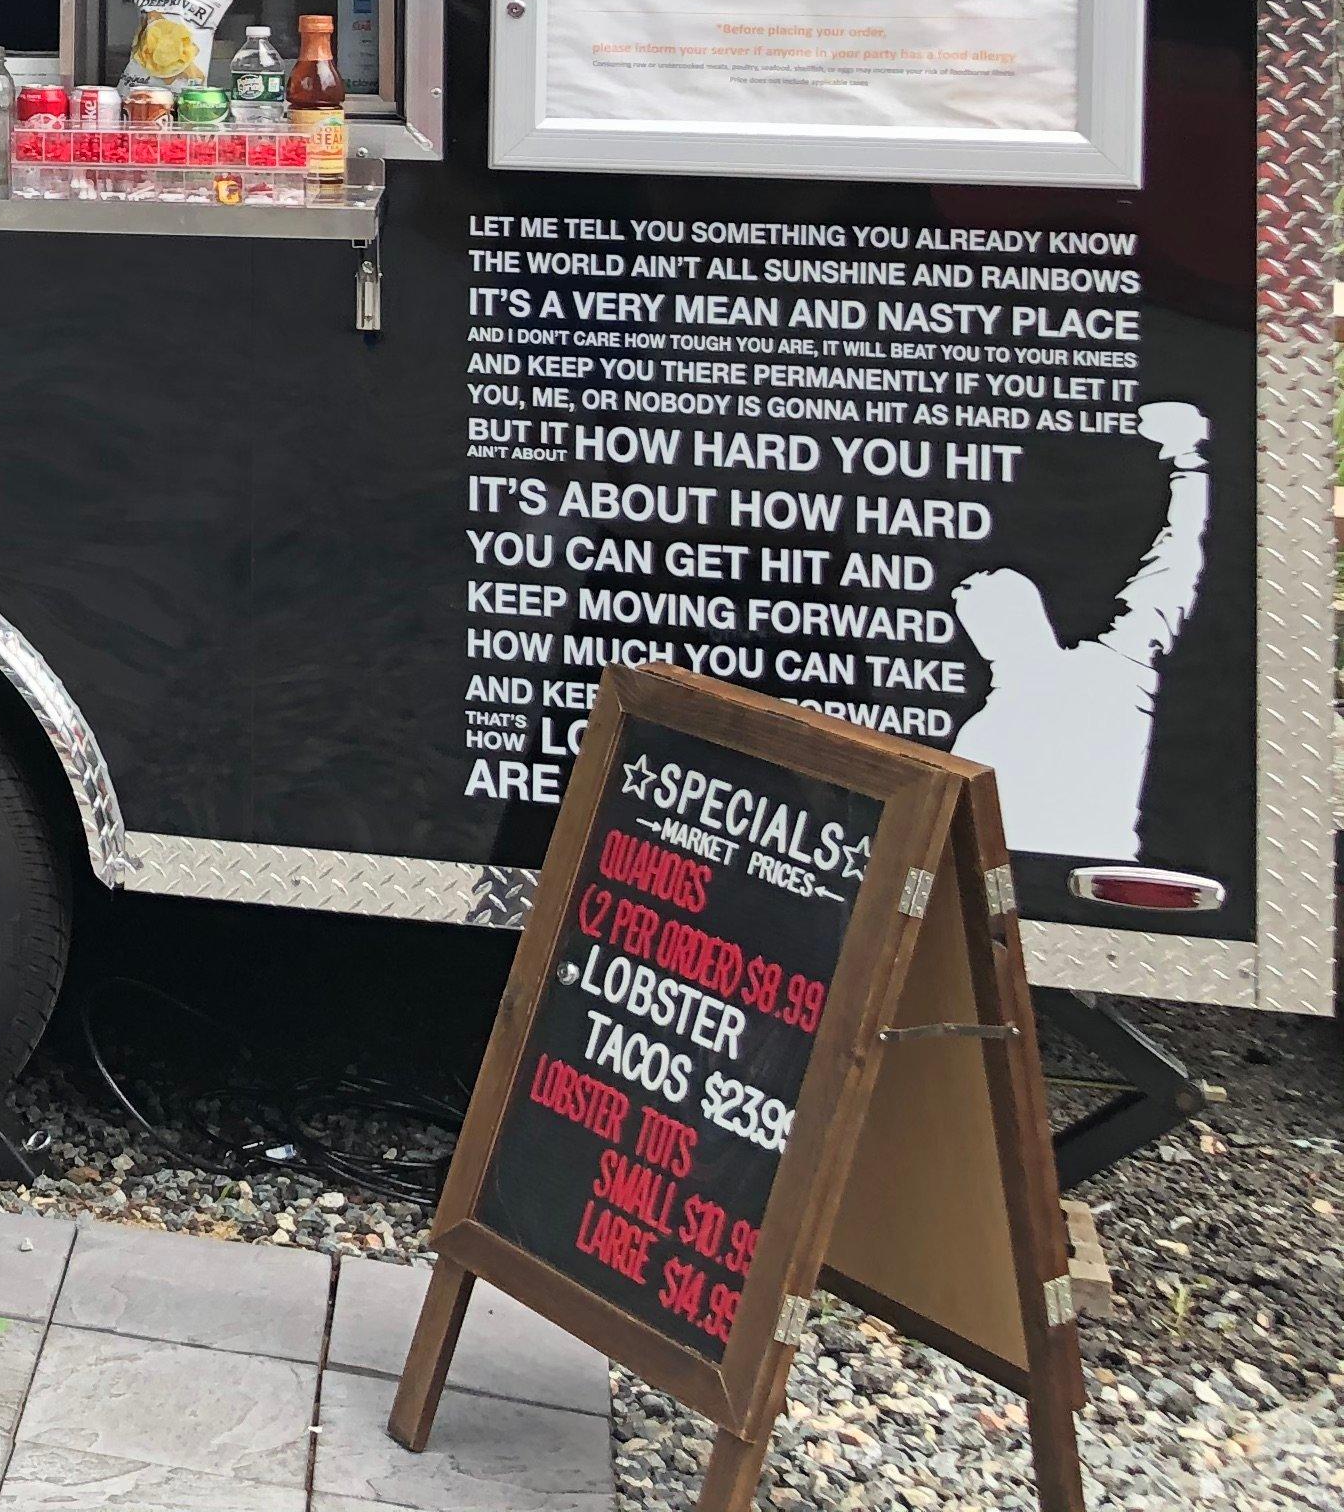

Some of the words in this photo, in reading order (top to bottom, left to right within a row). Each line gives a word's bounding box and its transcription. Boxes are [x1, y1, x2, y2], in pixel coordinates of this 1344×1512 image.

[467, 327, 503, 342] AND
[508, 329, 513, 342] I
[518, 329, 570, 345] DON'T
[574, 331, 620, 347] CARE
[625, 333, 666, 348] HOW
[670, 335, 732, 351] TOUGH
[736, 337, 773, 353] YOU
[778, 339, 818, 357] ARE,
[823, 340, 839, 355] IT
[843, 341, 887, 357] WILL
[891, 343, 937, 359] BEAT
[940, 345, 979, 361] YOU
[984, 347, 1010, 363] TO
[1014, 348, 1068, 365] YOUR
[1073, 350, 1137, 368] KNEES
[470, 288, 530, 317] IT'S
[539, 291, 565, 318] A
[573, 291, 665, 322] VERY
[676, 295, 778, 326] MEAN
[788, 299, 866, 329] AND
[879, 302, 1001, 334] NASTY
[1013, 307, 1139, 340] PLACE
[467, 445, 508, 458] AIN'T
[511, 447, 567, 461] ABOUT
[469, 418, 532, 442] BUT
[541, 422, 568, 444] IT
[576, 425, 680, 464] HOW
[694, 431, 820, 471] HARD
[832, 437, 930, 477] YOU
[947, 443, 1023, 482] HIT
[469, 476, 546, 515] IT'S
[559, 481, 717, 524] ABOUT
[731, 490, 842, 531] HOW
[857, 496, 991, 539] HARD
[466, 530, 552, 568] YOU
[566, 536, 651, 574] CAN
[665, 542, 748, 579] GET
[762, 548, 829, 584] HIT
[840, 553, 934, 590] AND
[468, 581, 566, 617] KEEP
[580, 588, 735, 629] MOVING
[749, 599, 954, 643] FORWARD
[468, 628, 553, 662] HOW
[564, 635, 674, 667] MUCH
[685, 642, 763, 679] YOU
[776, 650, 854, 685] CAN
[866, 656, 965, 693] TAKE
[654, 763, 845, 870] SPECIALS
[600, 829, 712, 913] QUAHOGS
[661, 817, 739, 865] MARKET
[748, 851, 817, 898] PRICES
[579, 883, 612, 937] (2
[609, 899, 659, 959] PER
[657, 920, 742, 997] ORDER)
[741, 955, 825, 1033] $8.99
[581, 944, 746, 1060] LOBSTER
[588, 1010, 692, 1103] TACOS
[530, 1053, 630, 1144] LOBSTER
[635, 1105, 698, 1178] TOTS
[593, 1149, 677, 1236] SMALL
[576, 1200, 659, 1285] LARGE
